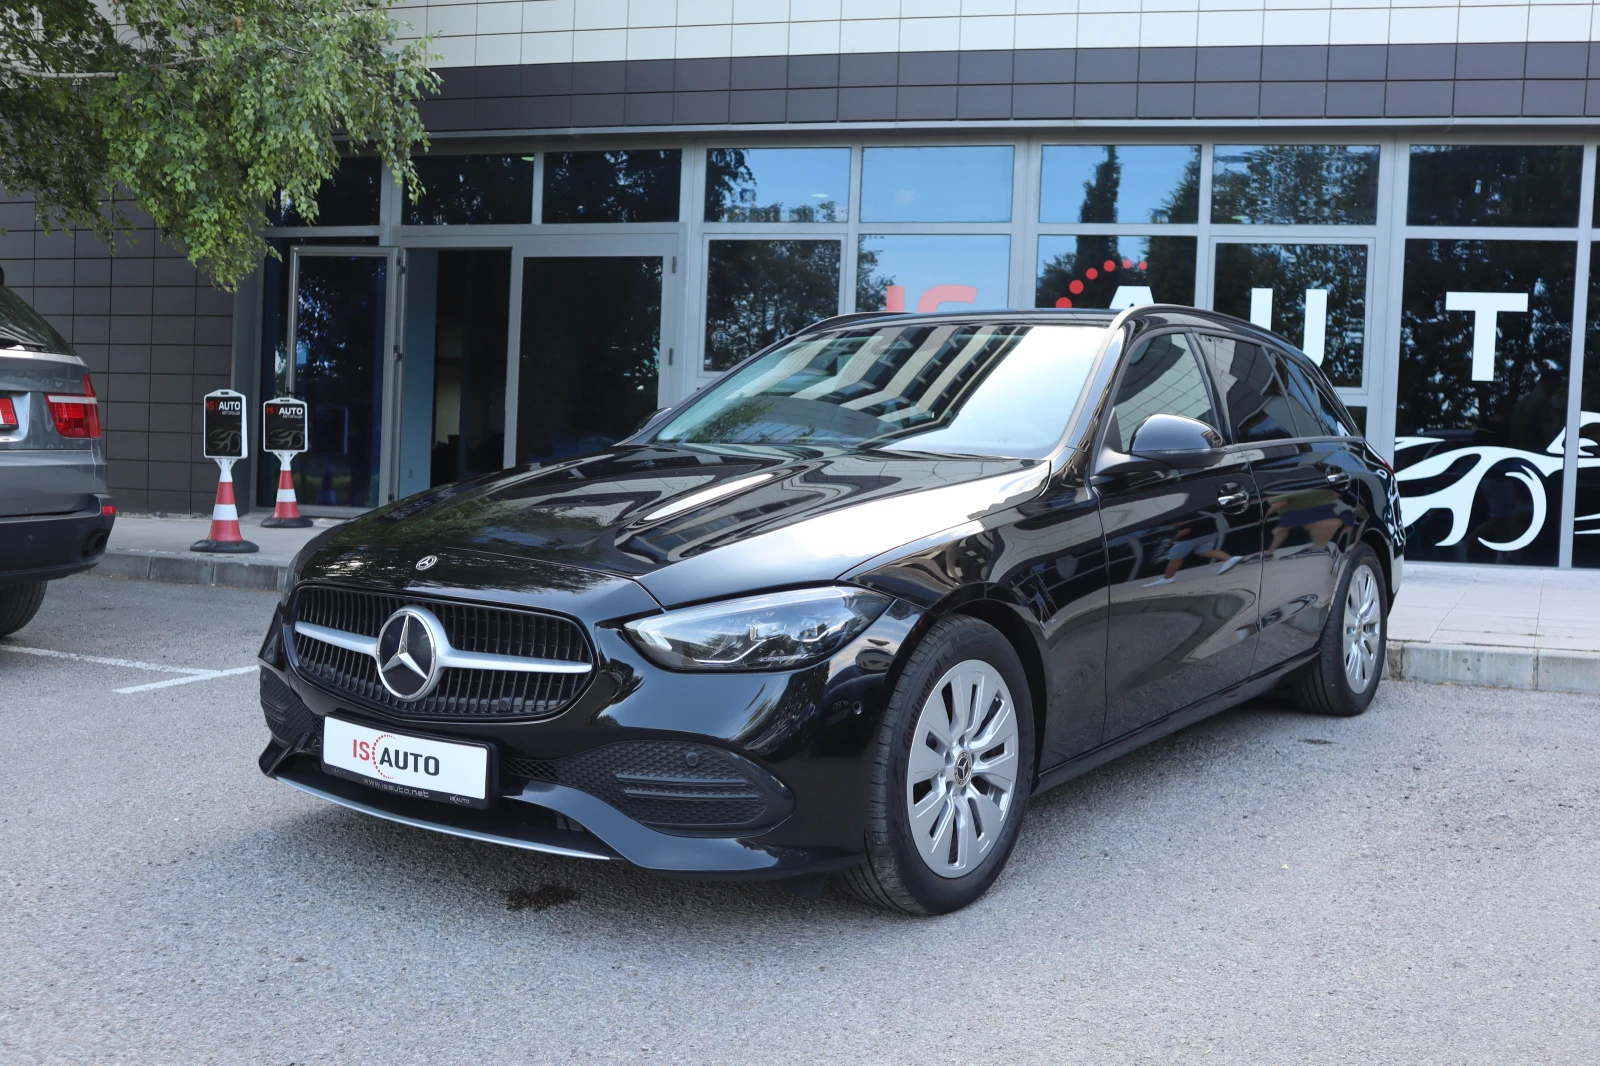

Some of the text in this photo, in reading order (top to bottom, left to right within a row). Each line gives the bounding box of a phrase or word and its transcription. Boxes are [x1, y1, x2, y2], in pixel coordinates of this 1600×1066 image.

[219, 401, 240, 410] AUTO
[279, 407, 303, 415] AUTO
[353, 739, 440, 776] IS AUTO
[362, 778, 429, 798] www.isauto.net
